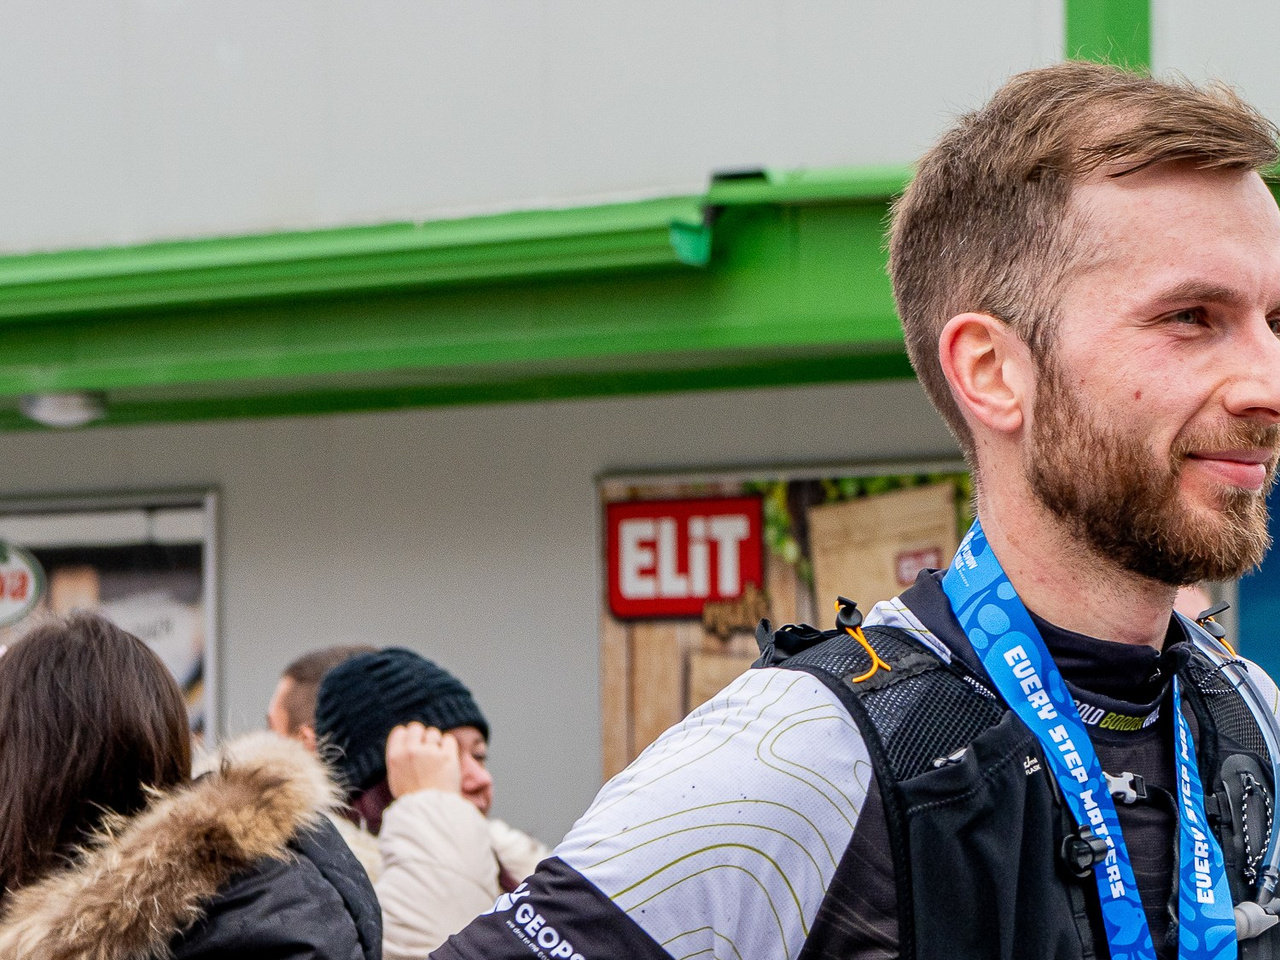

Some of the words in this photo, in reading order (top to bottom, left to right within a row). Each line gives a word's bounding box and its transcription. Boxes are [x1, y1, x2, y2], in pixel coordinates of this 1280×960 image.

[1048, 724, 1089, 784] STEP
[1080, 789, 1126, 899] MATTERS
[1182, 764, 1195, 823] STEP
